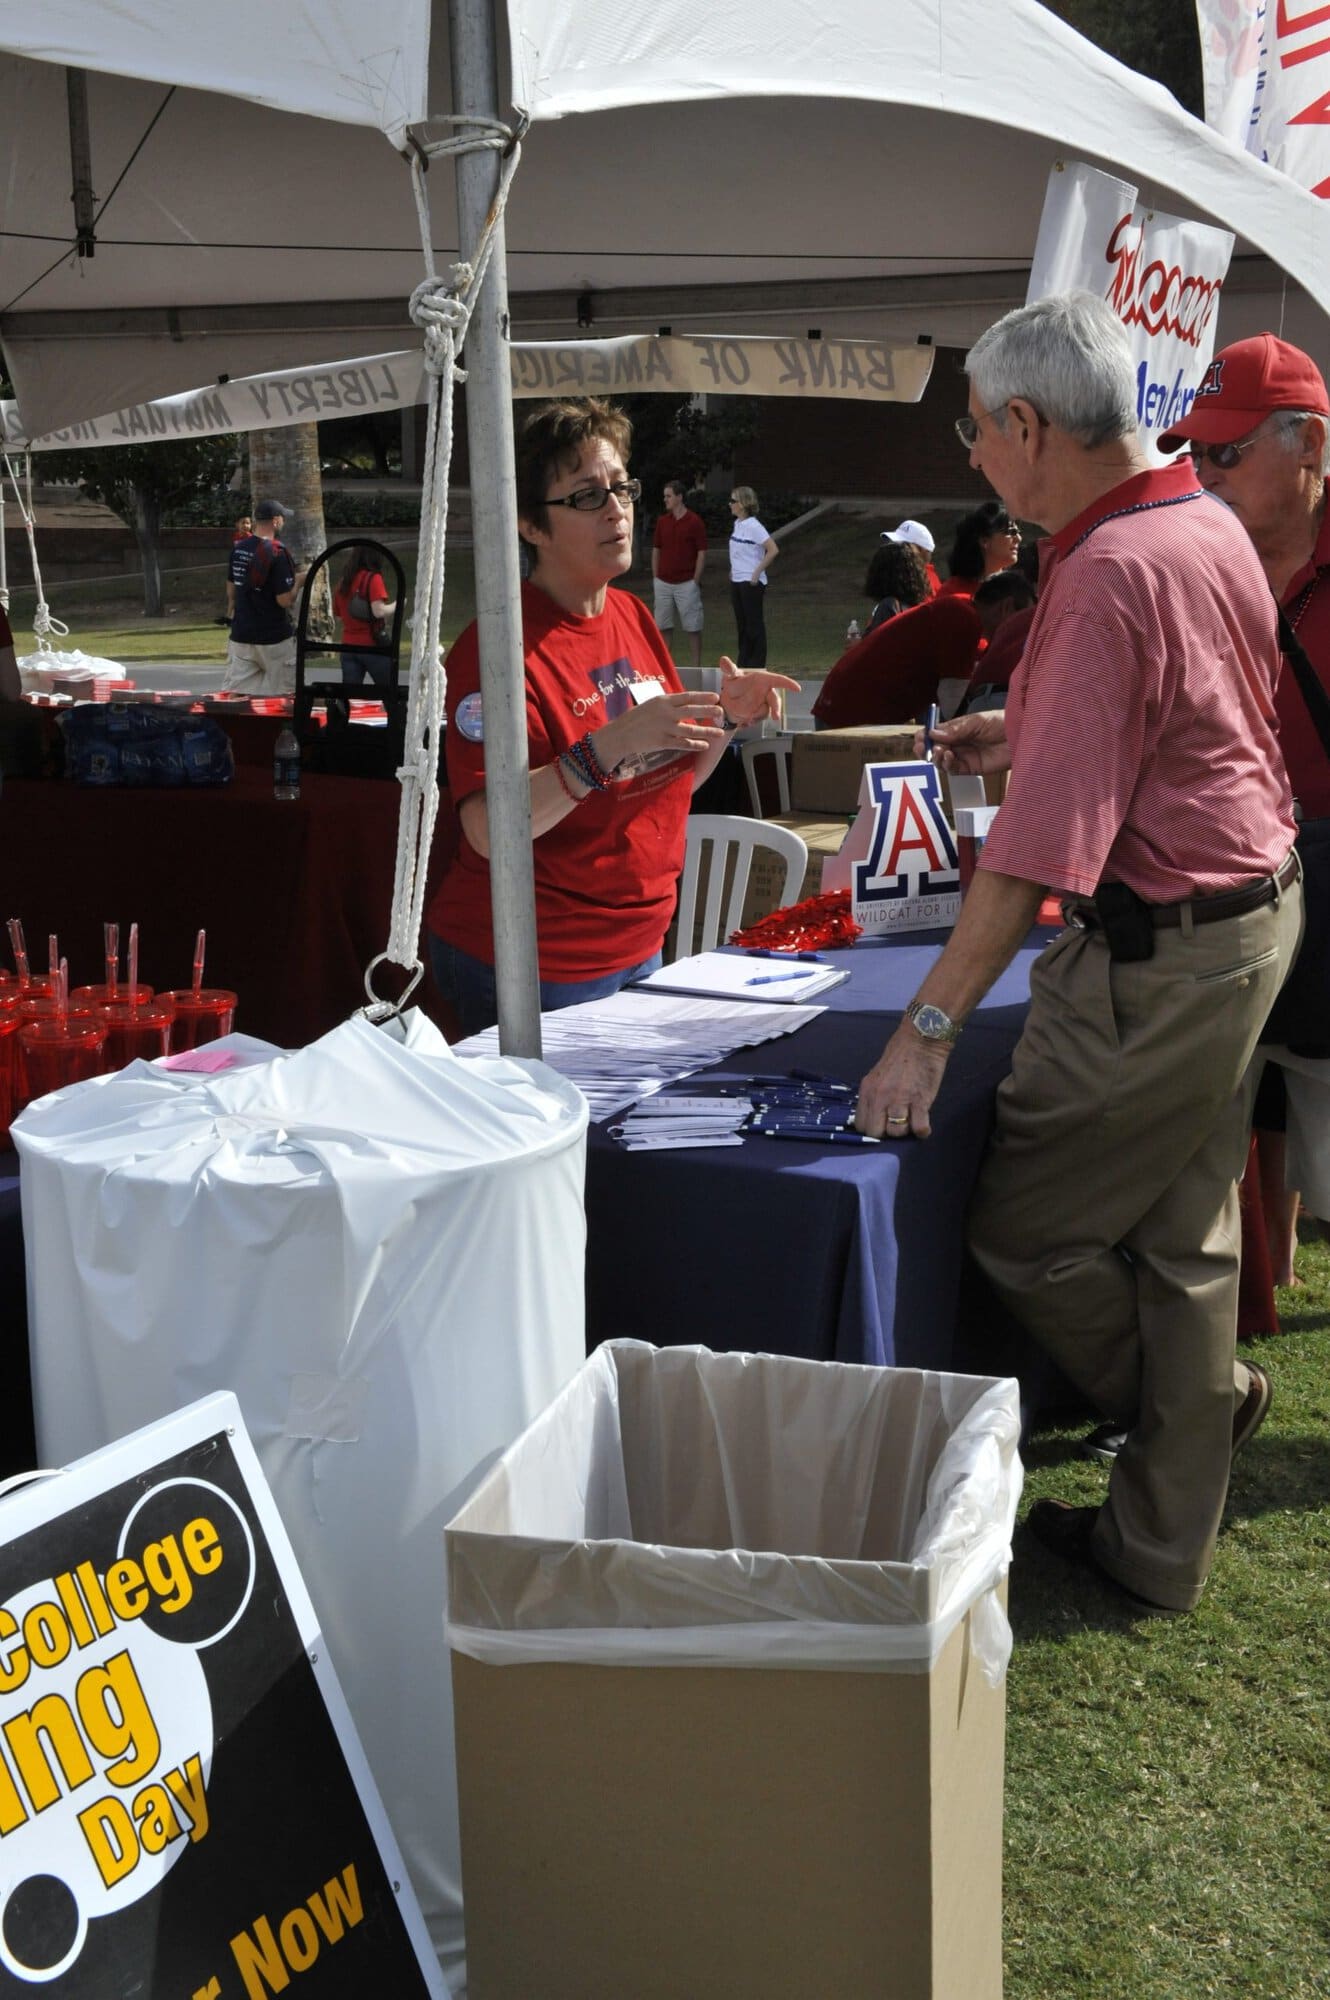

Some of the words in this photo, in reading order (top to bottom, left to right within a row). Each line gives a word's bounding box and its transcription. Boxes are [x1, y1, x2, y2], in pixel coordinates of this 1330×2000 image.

[1195, 360, 1225, 397] A
[572, 692, 601, 717] One
[597, 680, 615, 702] for
[856, 764, 960, 903] A
[856, 907, 911, 924] WILDCAT
[917, 903, 941, 917] FOR
[946, 900, 960, 914] LI
[0, 1517, 224, 1694] College
[76, 1753, 210, 1891] Day
[229, 1863, 365, 2000] Now
